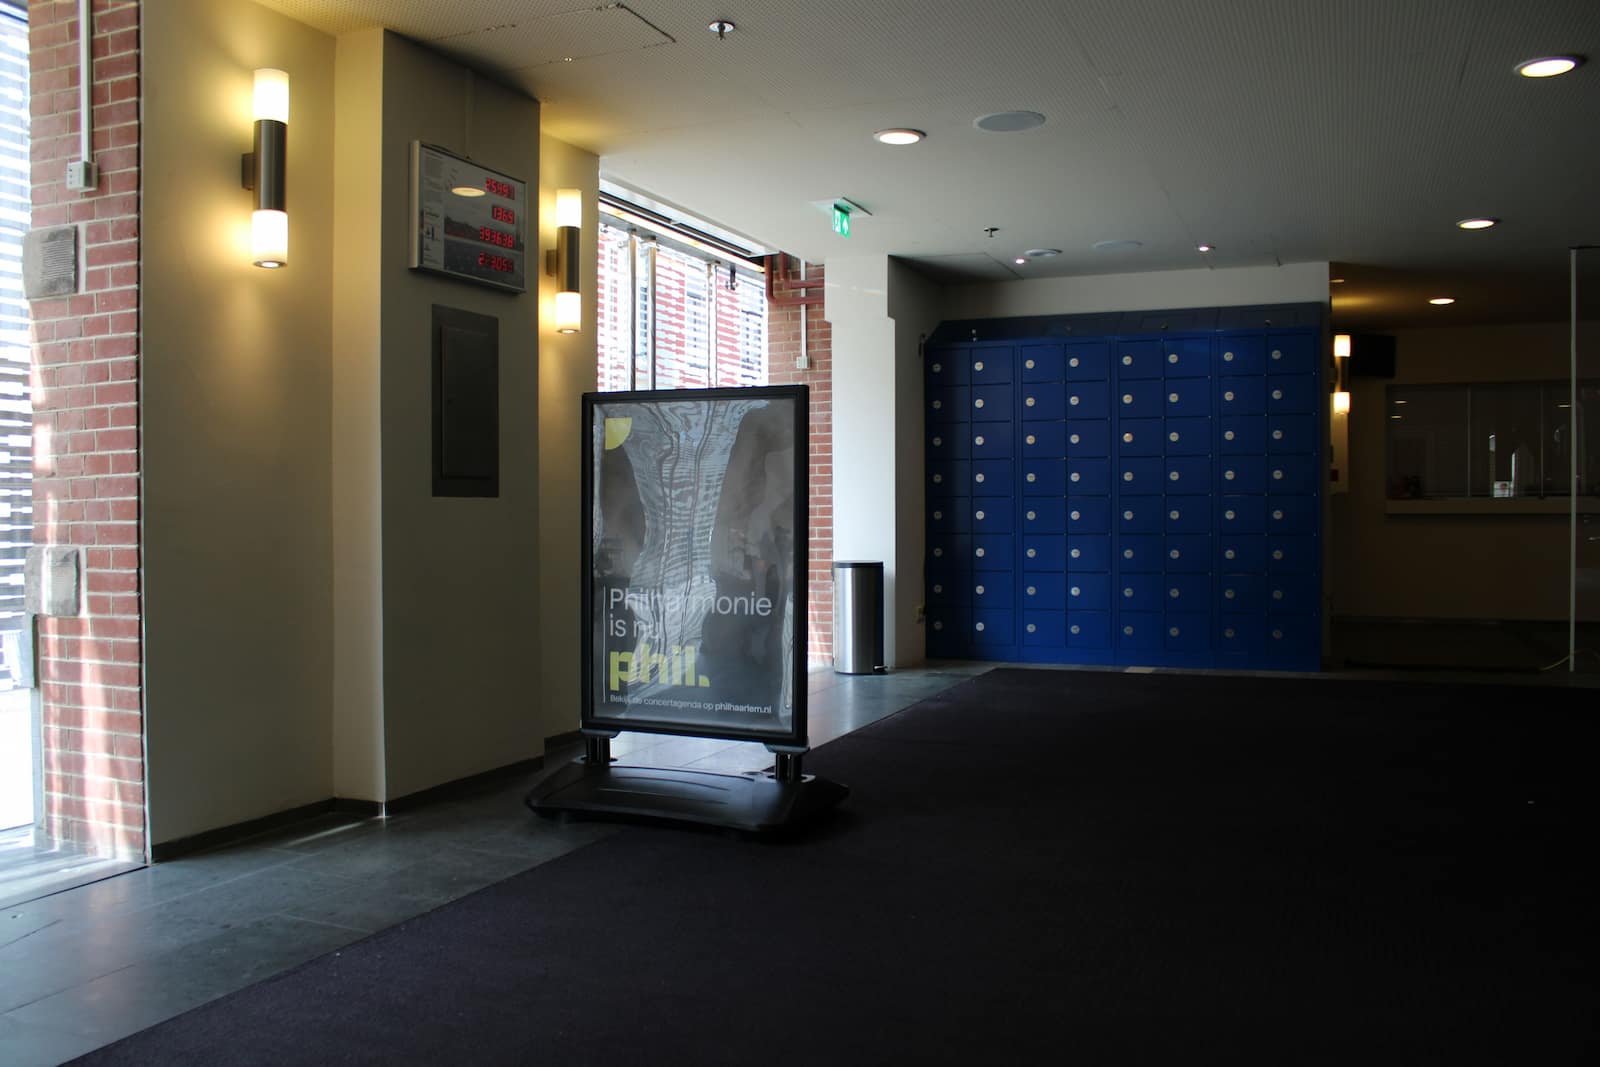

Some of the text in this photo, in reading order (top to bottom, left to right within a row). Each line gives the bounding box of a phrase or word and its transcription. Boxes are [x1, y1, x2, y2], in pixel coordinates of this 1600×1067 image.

[493, 207, 514, 224] 1369
[610, 614, 627, 637] is
[643, 698, 702, 711] concertagenda
[703, 702, 714, 711] op
[714, 703, 772, 714] philhaarlem.nl
